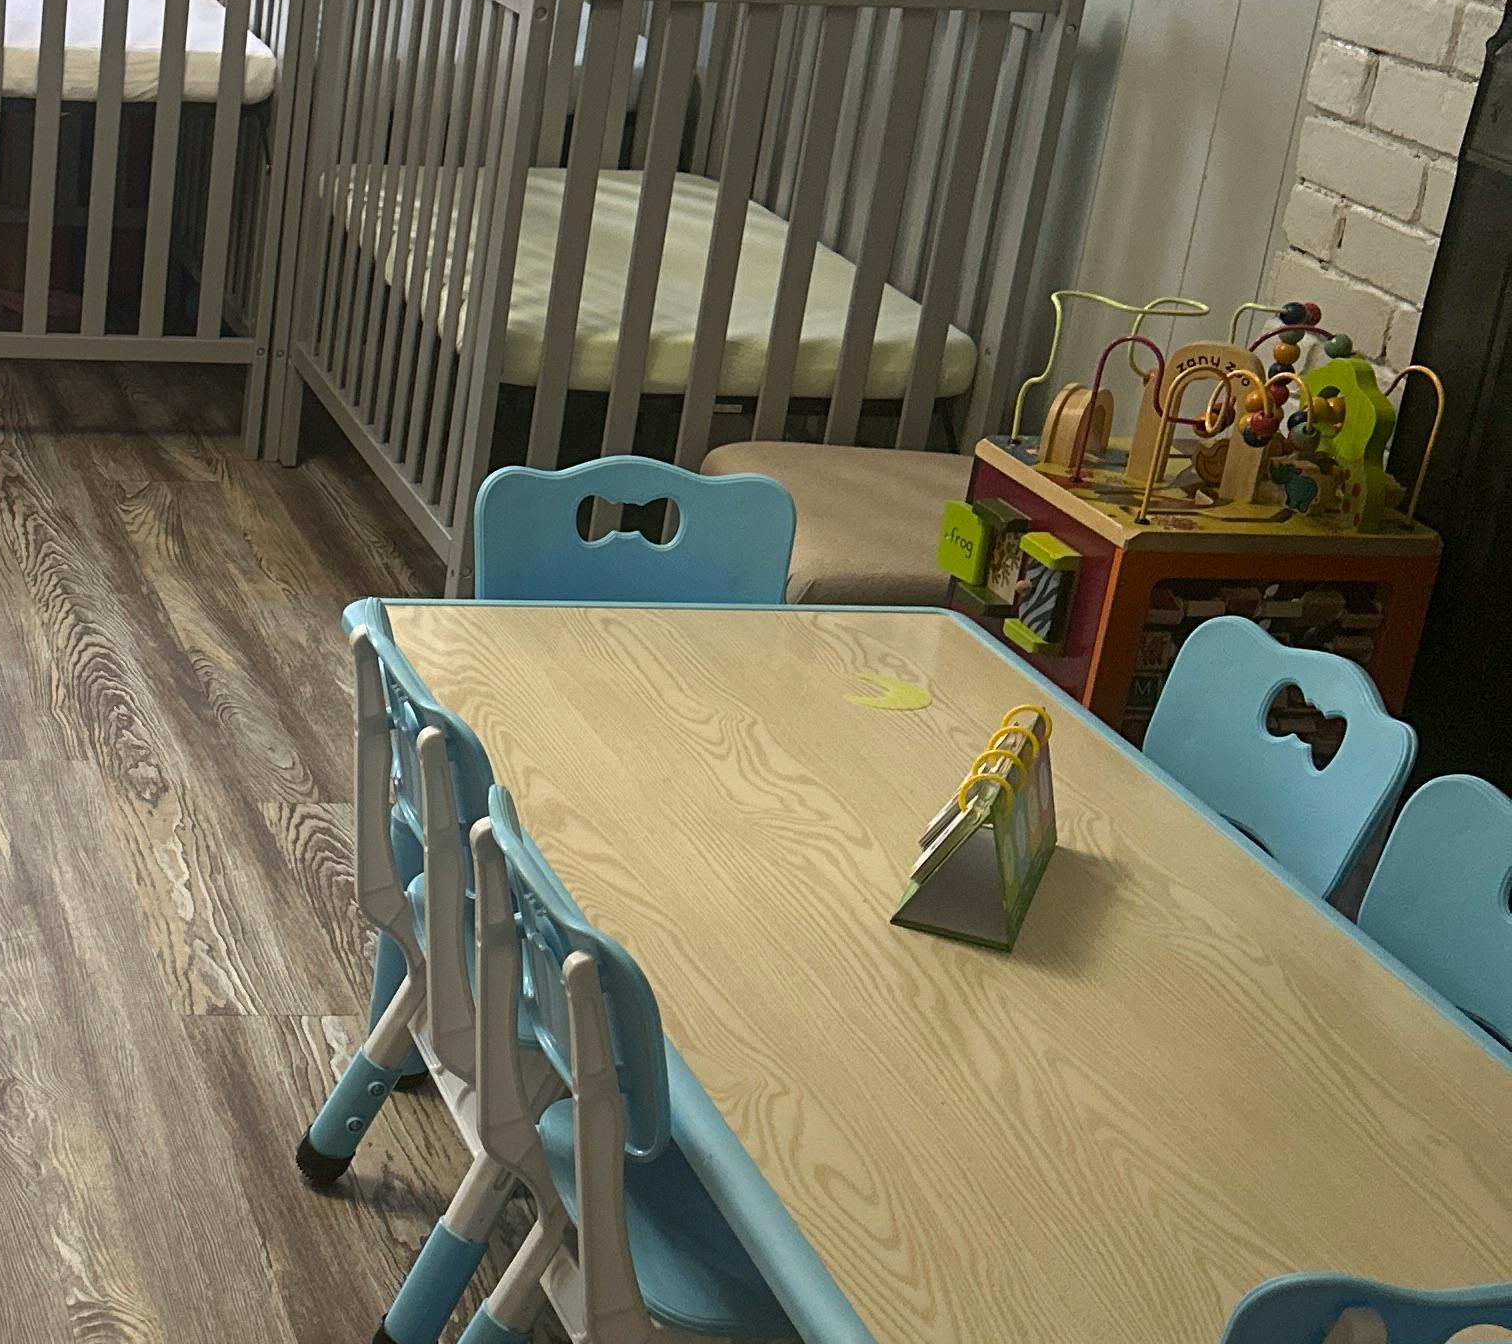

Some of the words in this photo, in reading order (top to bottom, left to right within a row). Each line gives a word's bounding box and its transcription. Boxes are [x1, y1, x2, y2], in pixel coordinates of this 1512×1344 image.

[1175, 355, 1221, 374] zany
[1224, 361, 1251, 387] zo
[946, 525, 975, 560] frog
